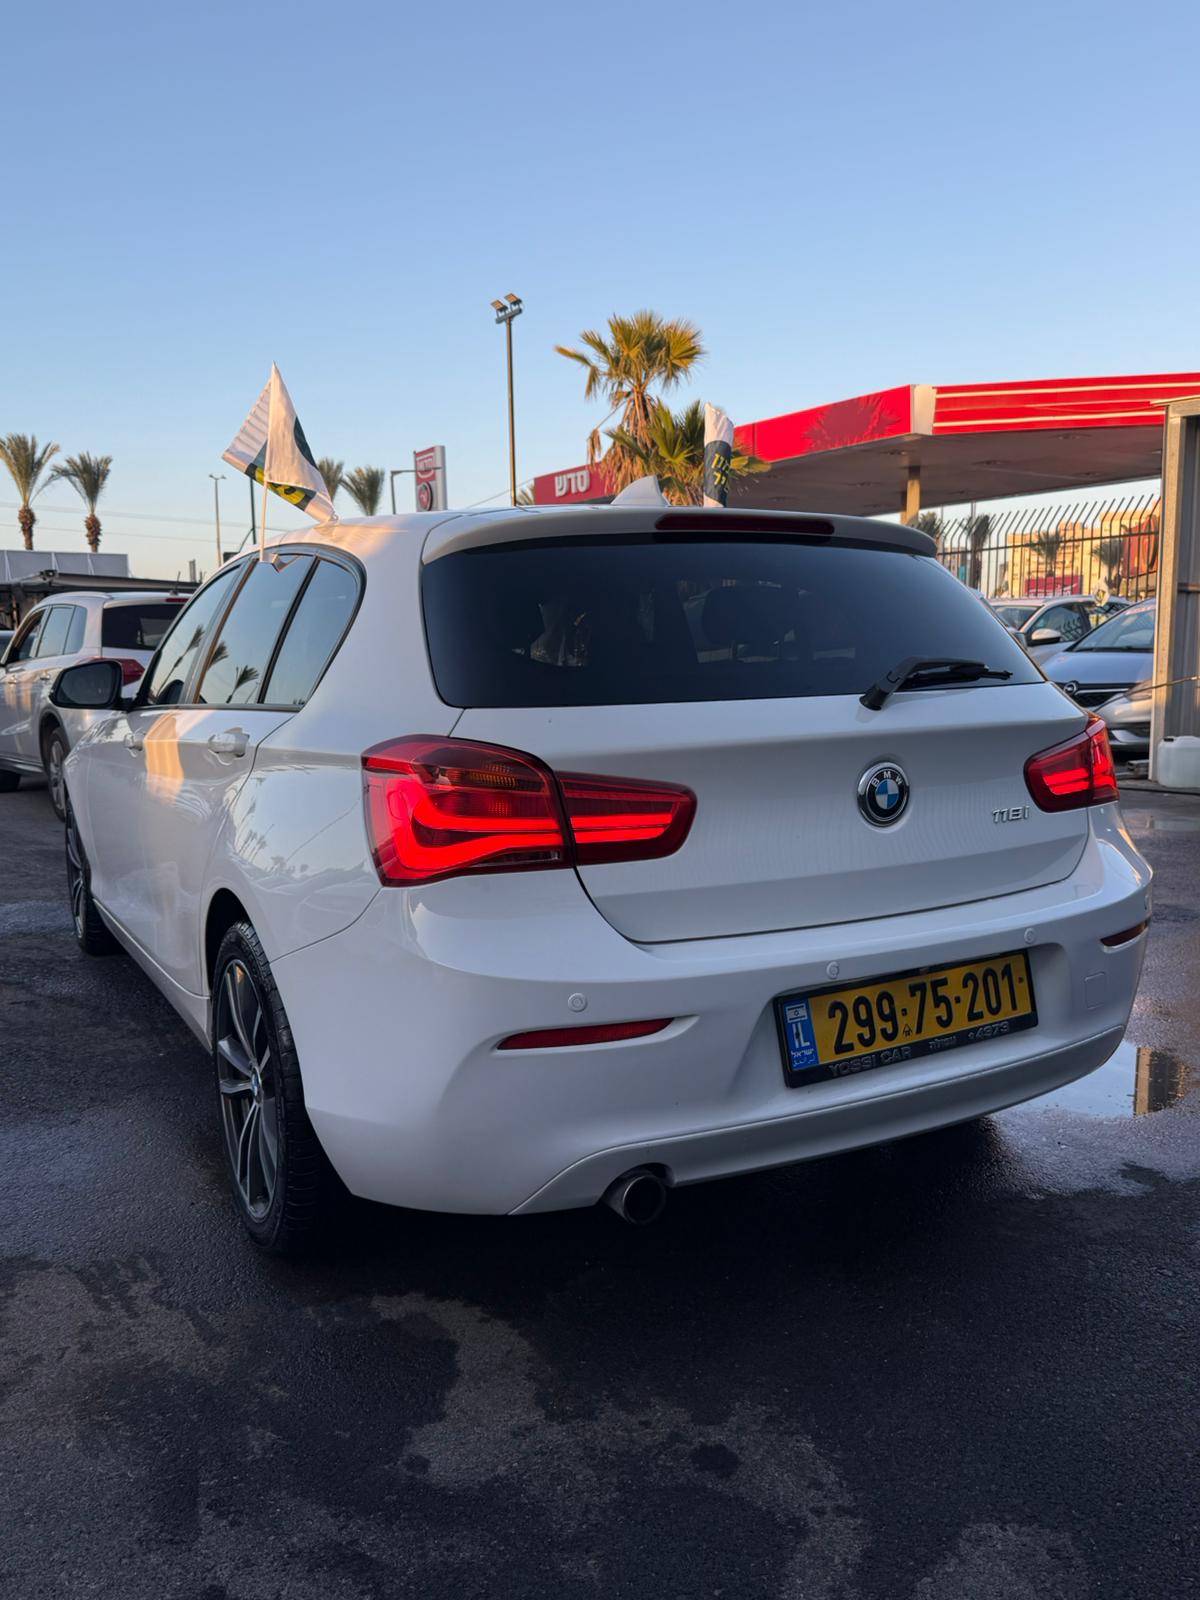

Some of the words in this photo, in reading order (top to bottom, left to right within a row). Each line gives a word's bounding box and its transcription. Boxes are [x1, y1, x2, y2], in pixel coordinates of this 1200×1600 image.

[871, 771, 903, 787] BMW
[992, 805, 1030, 824] 118i
[792, 1022, 811, 1049] IL
[829, 1054, 877, 1077] YOSSI
[880, 1046, 912, 1062] CAR
